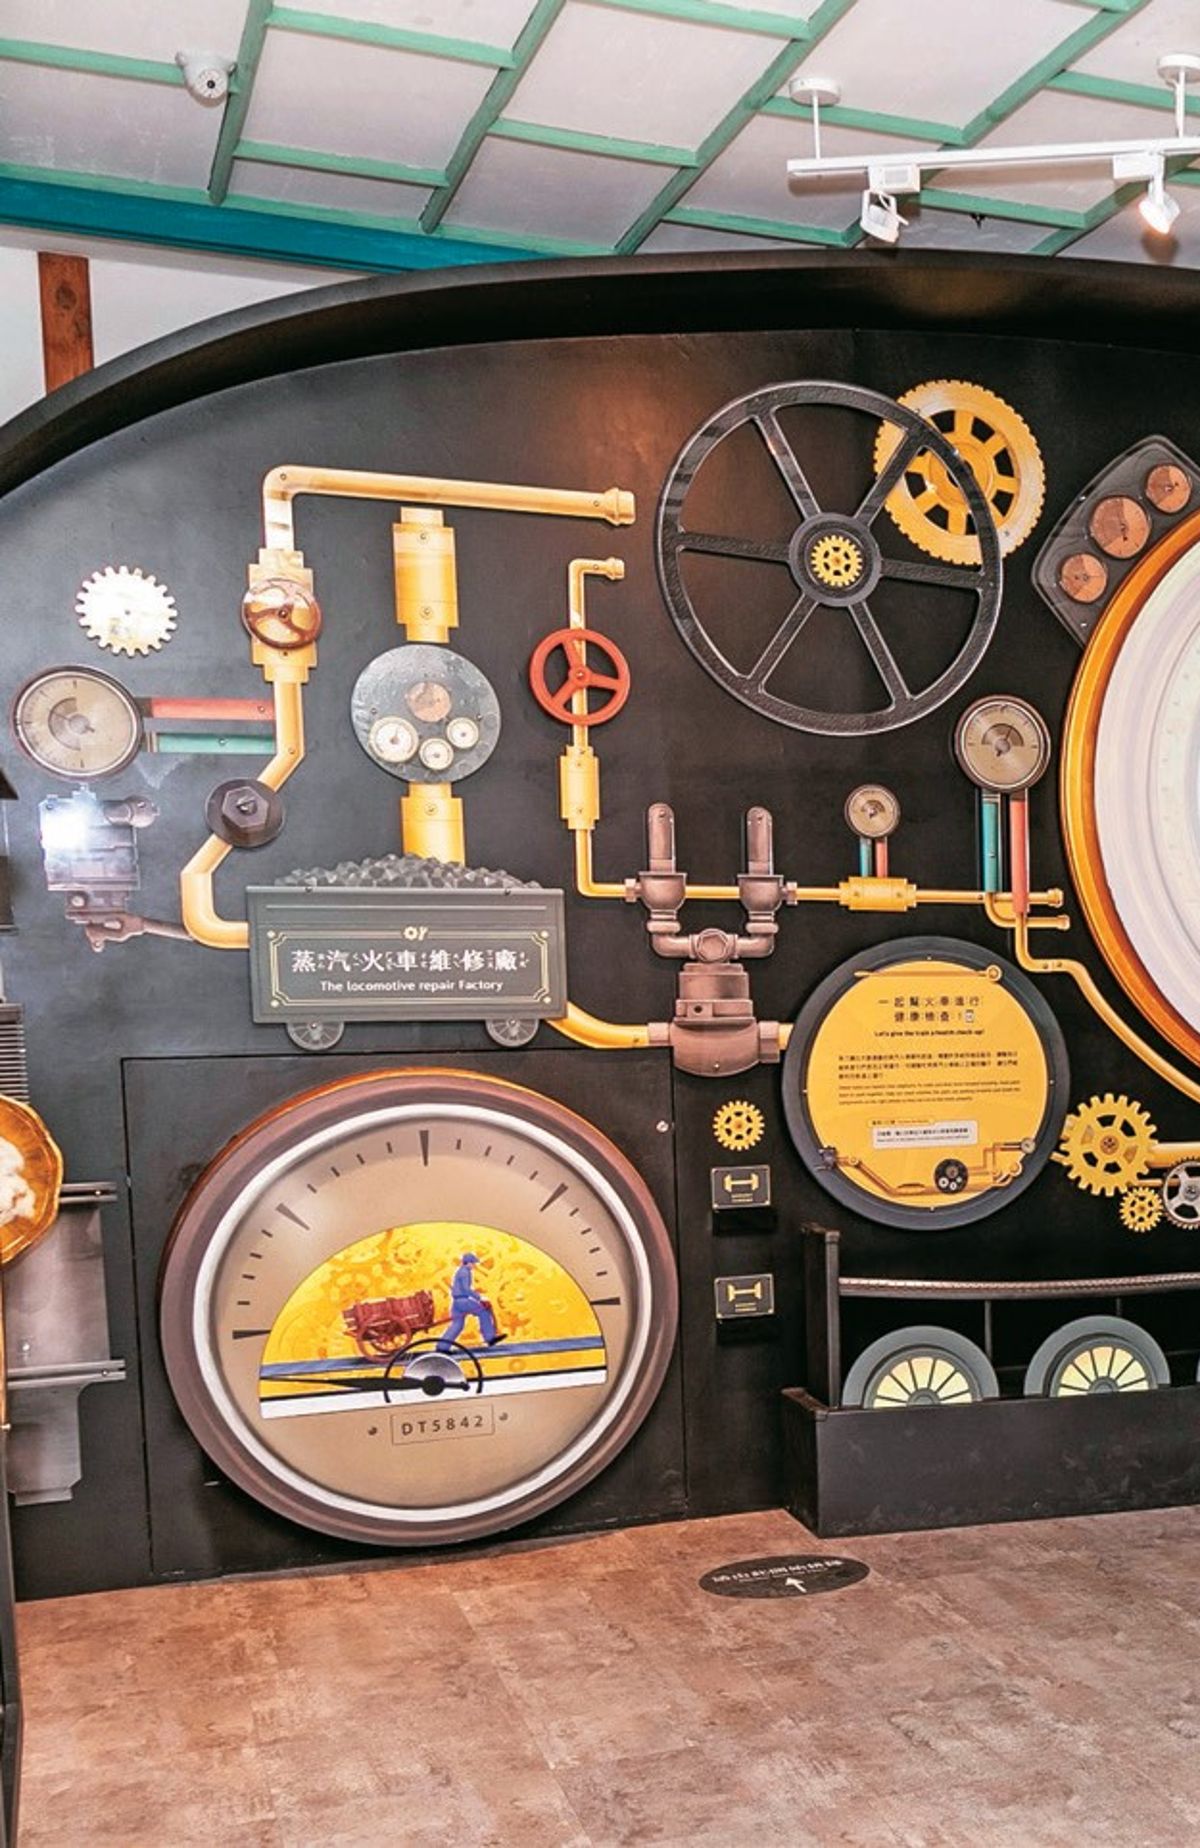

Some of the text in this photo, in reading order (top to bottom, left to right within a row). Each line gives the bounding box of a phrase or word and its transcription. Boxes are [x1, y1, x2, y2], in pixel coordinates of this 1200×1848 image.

[291, 949, 518, 972] 蒸汽火車維修廠
[320, 980, 343, 992] The
[346, 979, 415, 992] locomotive
[419, 979, 455, 993] repair
[401, 1414, 484, 1436] DT5842
